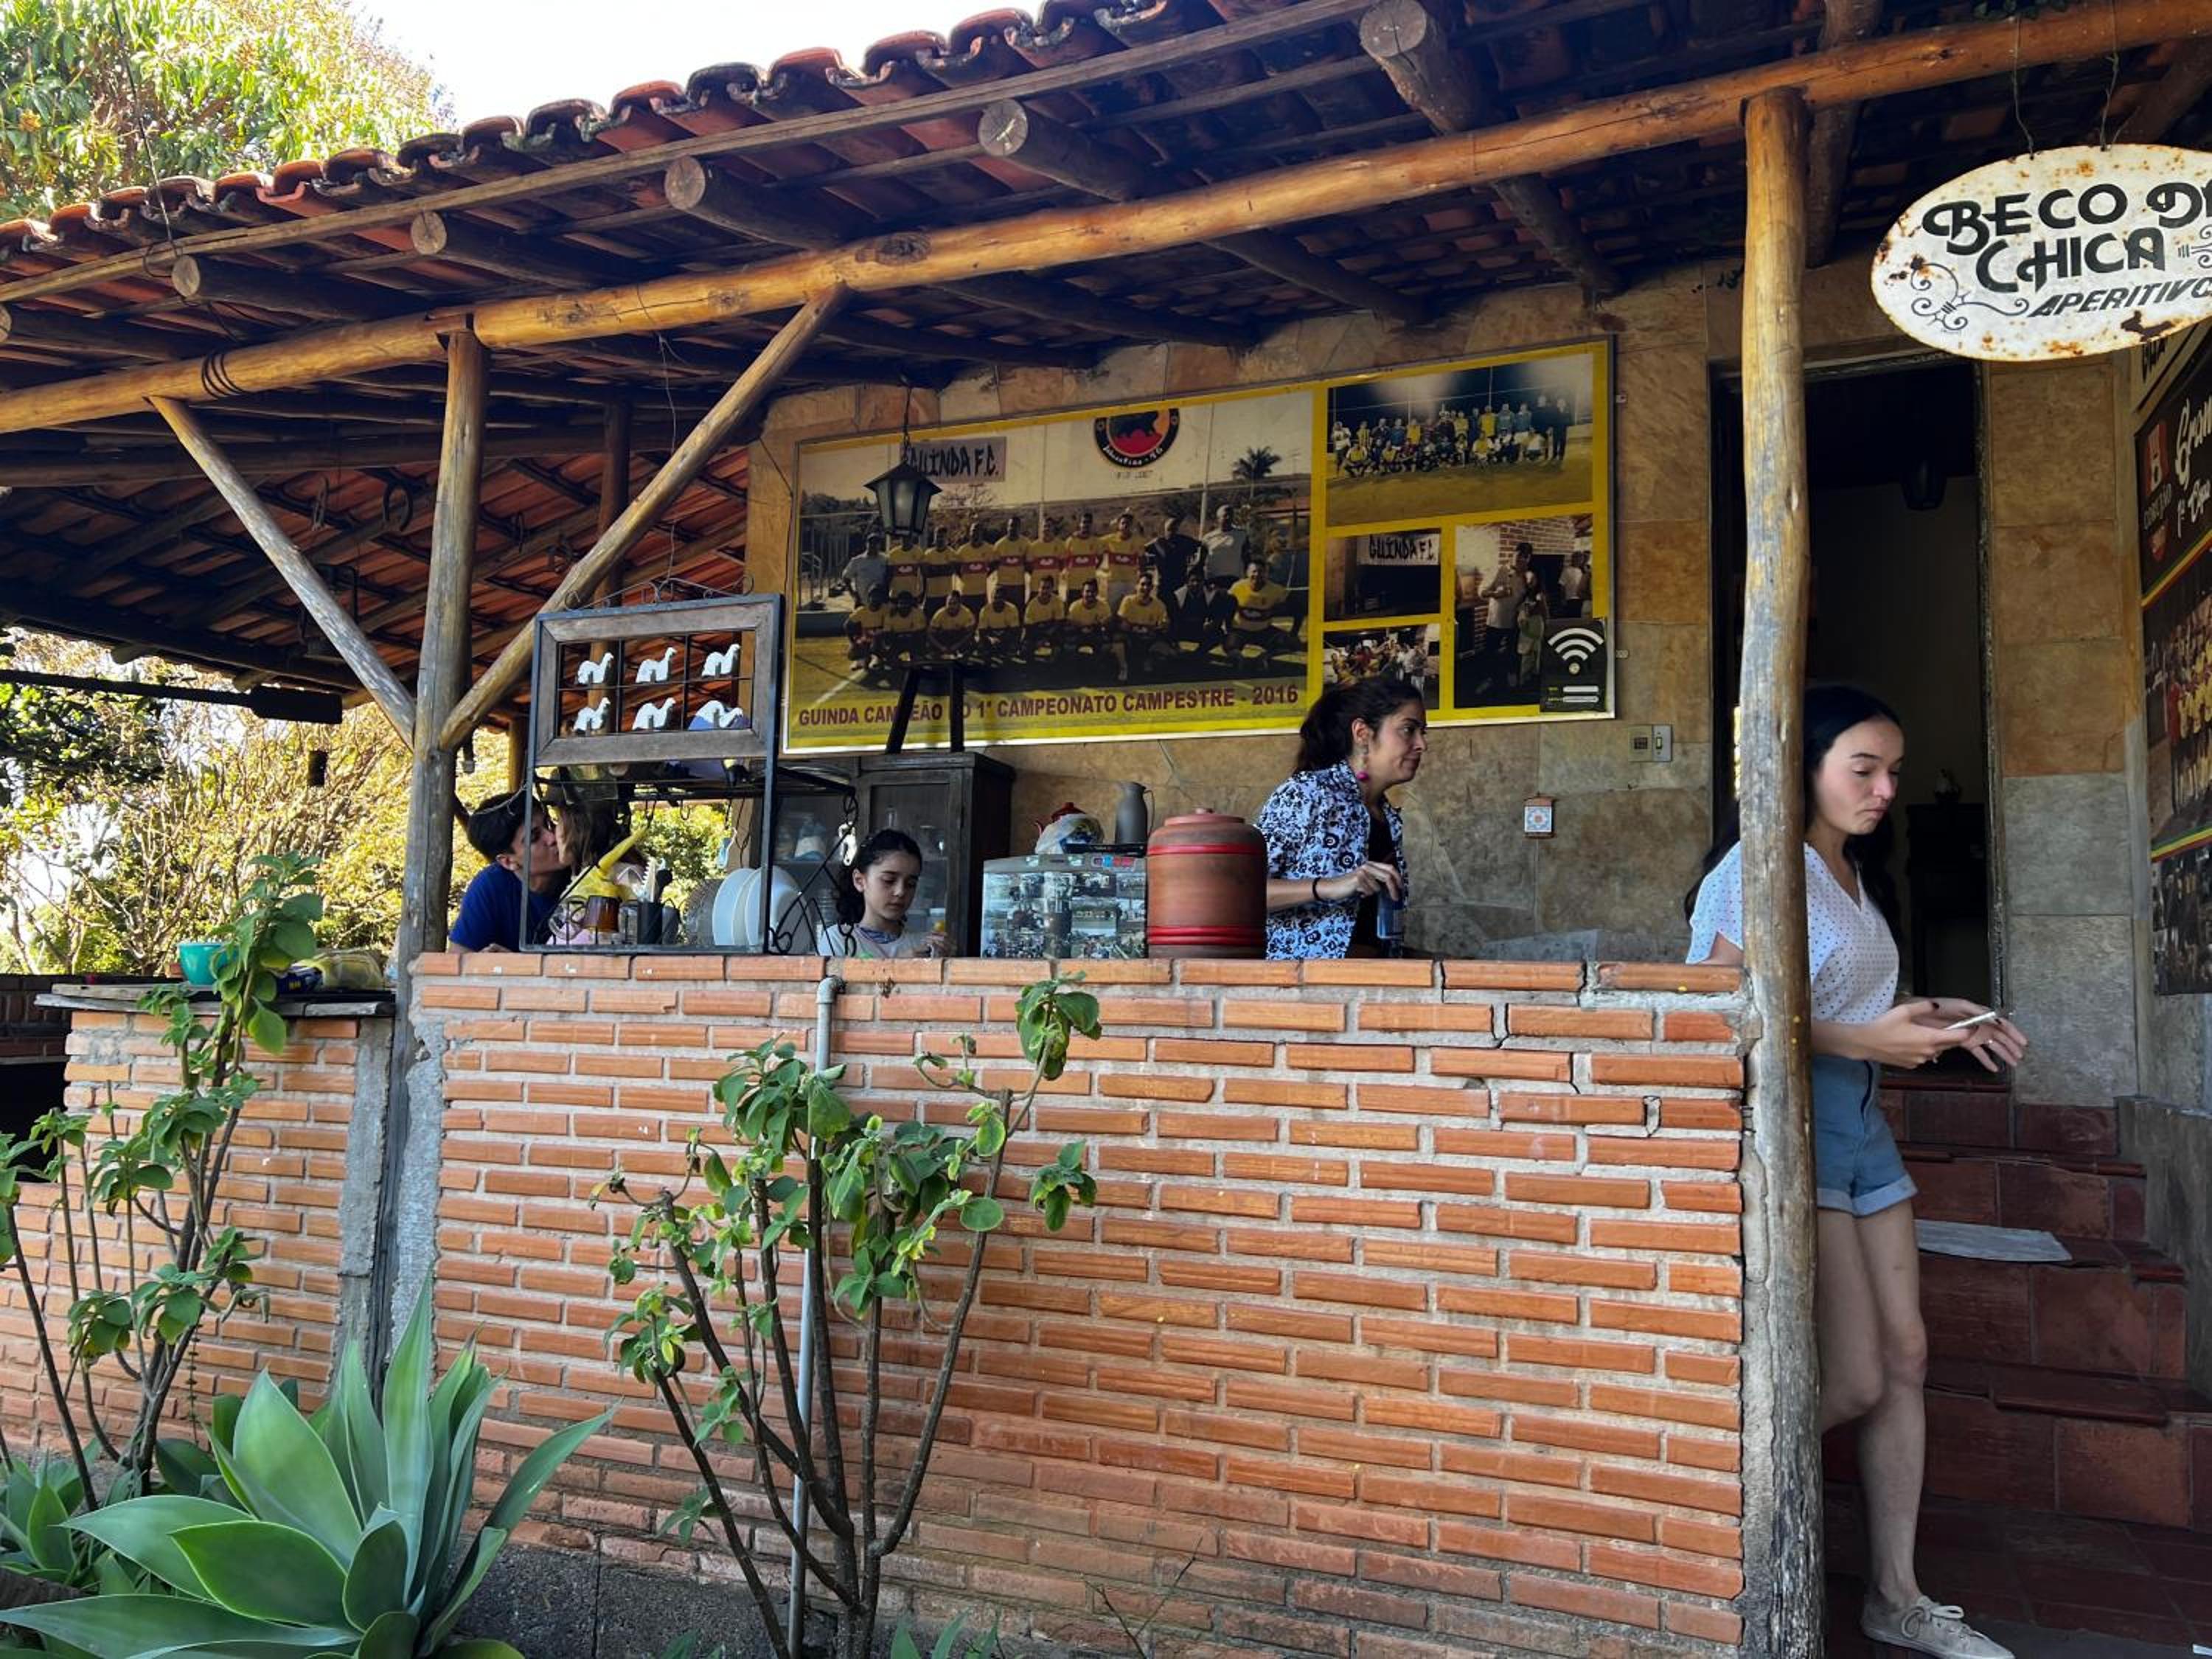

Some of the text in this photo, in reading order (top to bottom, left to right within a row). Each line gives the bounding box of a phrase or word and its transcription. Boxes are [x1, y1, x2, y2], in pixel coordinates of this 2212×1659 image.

[1921, 179, 2212, 255] BECO D
[1975, 226, 2166, 293] CHICA
[974, 445, 999, 476] F.C.
[799, 706, 860, 726] GUINDA
[864, 700, 943, 723] CAMEÃO
[997, 694, 1117, 718] CAMPEONATO
[1122, 686, 1236, 712] CAMPESTRE
[1253, 684, 1299, 706] 2016
